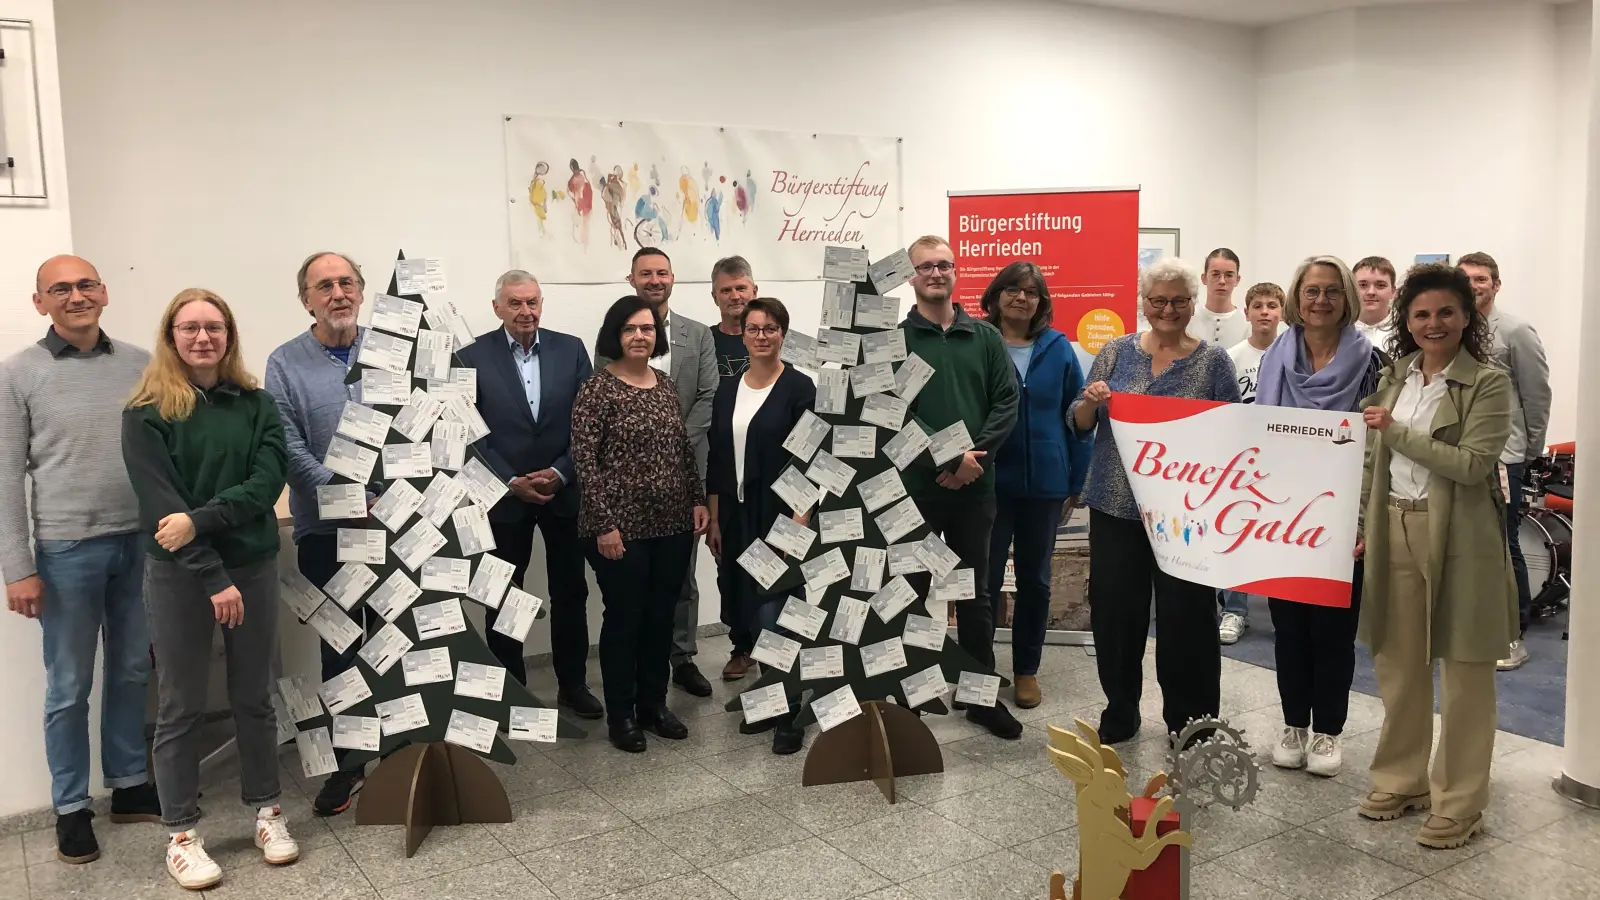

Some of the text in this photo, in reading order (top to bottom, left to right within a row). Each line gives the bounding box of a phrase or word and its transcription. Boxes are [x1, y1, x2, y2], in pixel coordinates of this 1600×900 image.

[770, 160, 889, 222] Bürgerstiftung
[777, 210, 864, 245] Herrieden
[959, 212, 1082, 236] Bürgerstiftung
[959, 239, 1042, 257] Herrieden
[1267, 423, 1333, 438] HERRIEDEN
[1131, 439, 1291, 511] Benefiz
[1213, 491, 1335, 555] Gala
